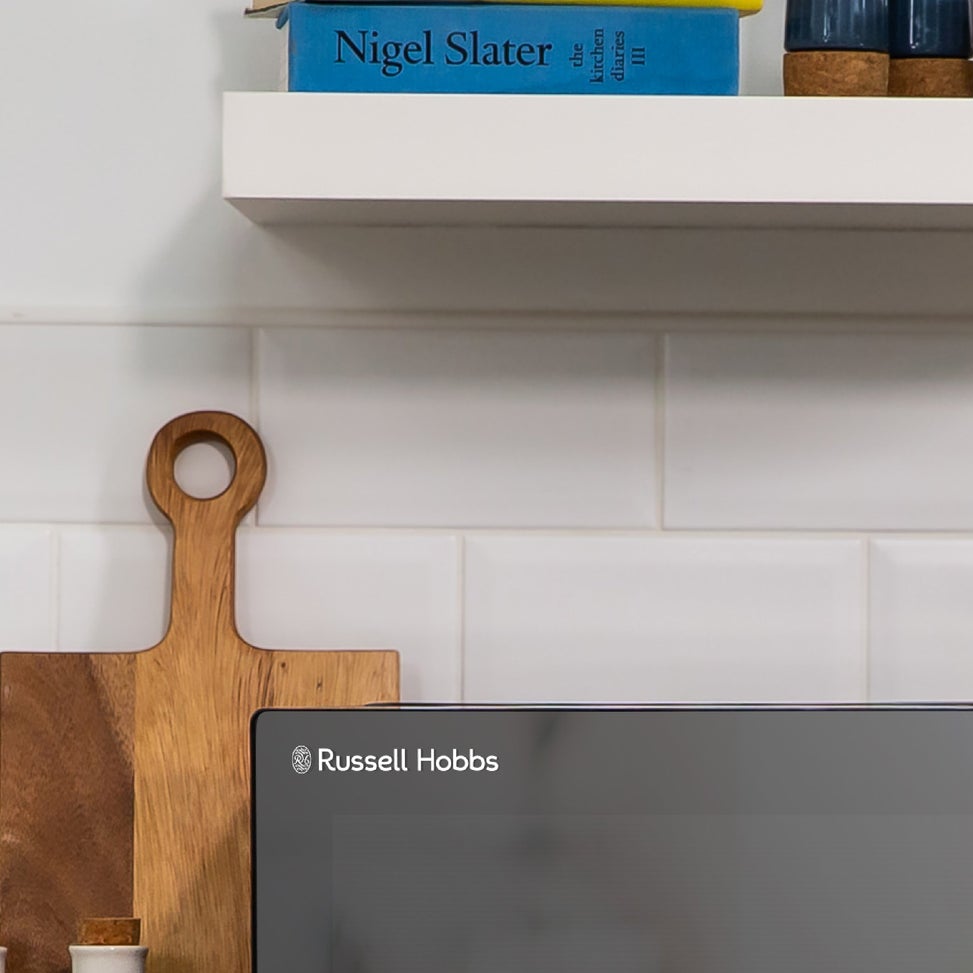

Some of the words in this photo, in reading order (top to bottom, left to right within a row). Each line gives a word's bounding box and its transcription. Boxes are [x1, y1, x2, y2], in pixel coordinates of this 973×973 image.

[334, 30, 435, 77] Nigel
[445, 30, 553, 66] Slater
[568, 43, 584, 68] the
[589, 28, 604, 83] kitchen
[610, 30, 625, 82] diaries
[318, 747, 408, 772] Russell
[417, 748, 499, 772] Hobbs
